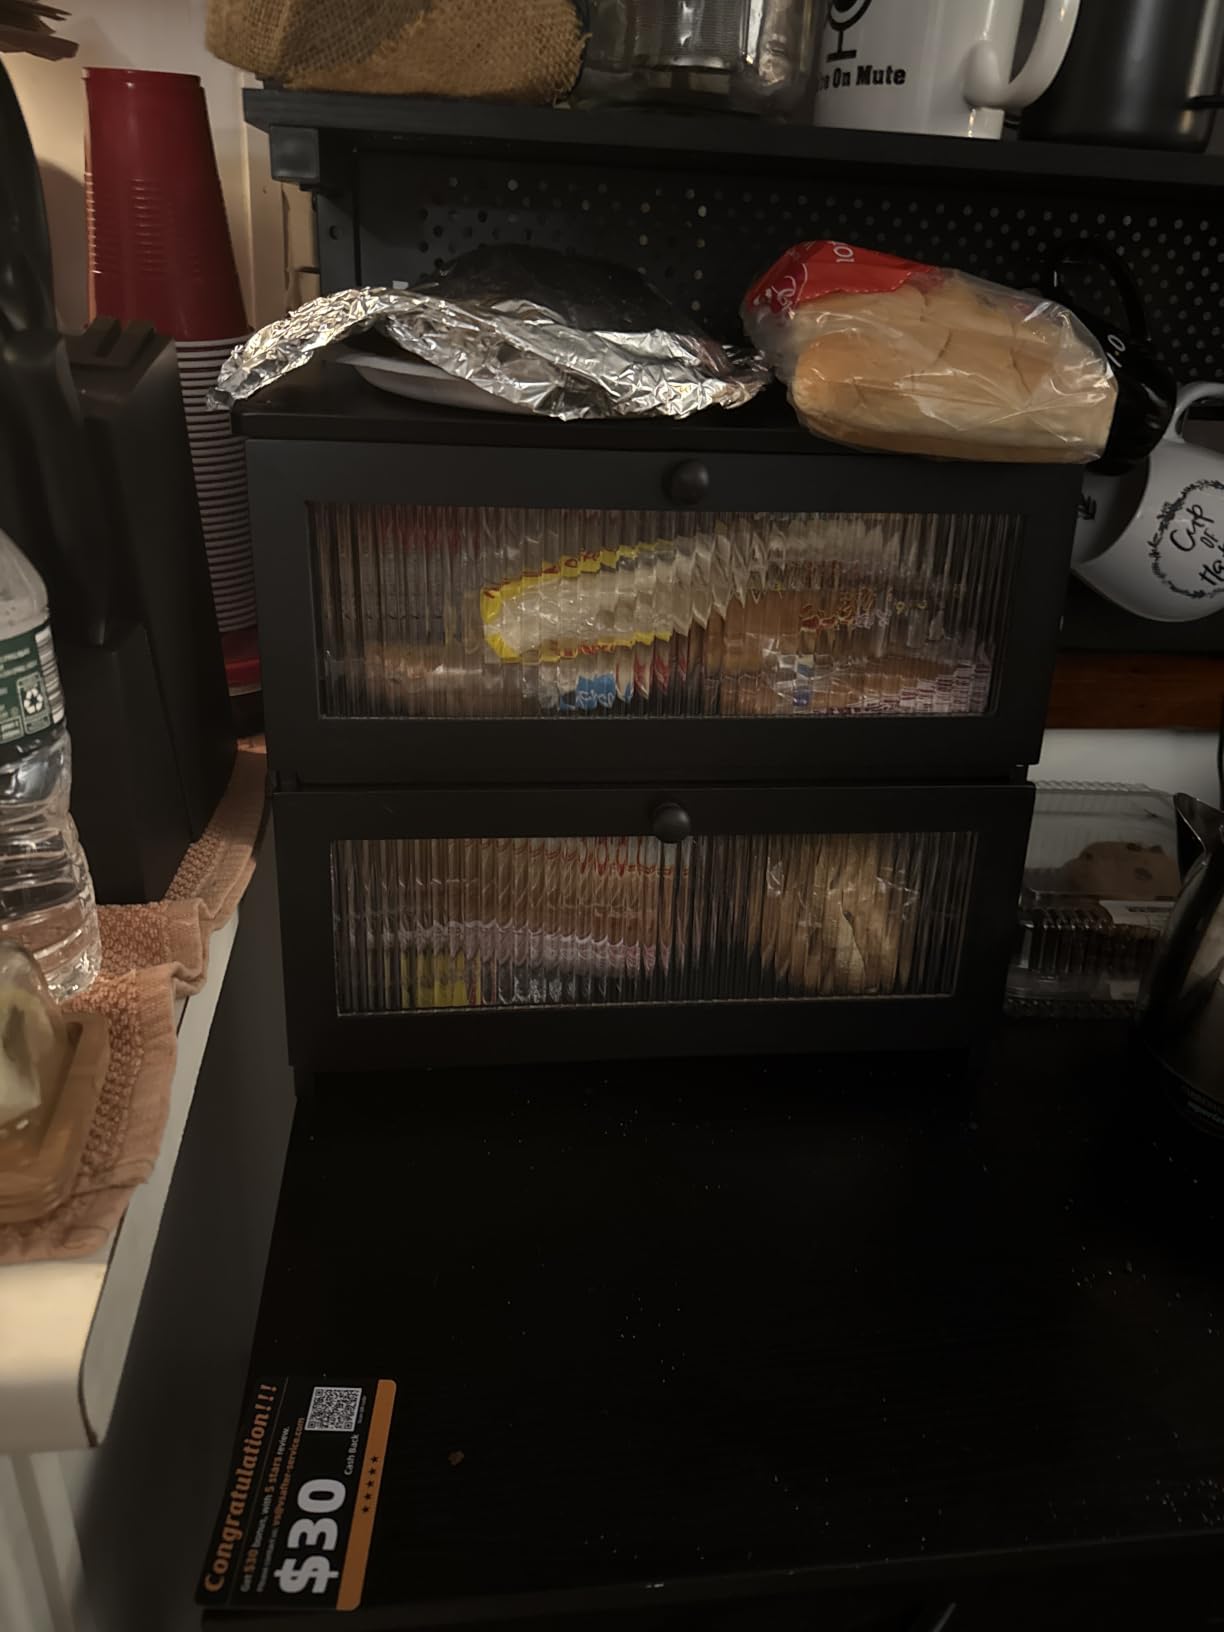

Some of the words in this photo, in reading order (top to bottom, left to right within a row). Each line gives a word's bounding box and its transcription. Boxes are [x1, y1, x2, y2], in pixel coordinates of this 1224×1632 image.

[832, 68, 850, 88] On
[856, 65, 906, 86] Mute
[1169, 504, 1215, 552] Cup
[347, 1434, 360, 1454] Back
[267, 1456, 283, 1483] stars
[344, 1455, 356, 1476] Cash
[203, 1383, 278, 1593] Congratulation!!!
[272, 1478, 347, 1595] $30
